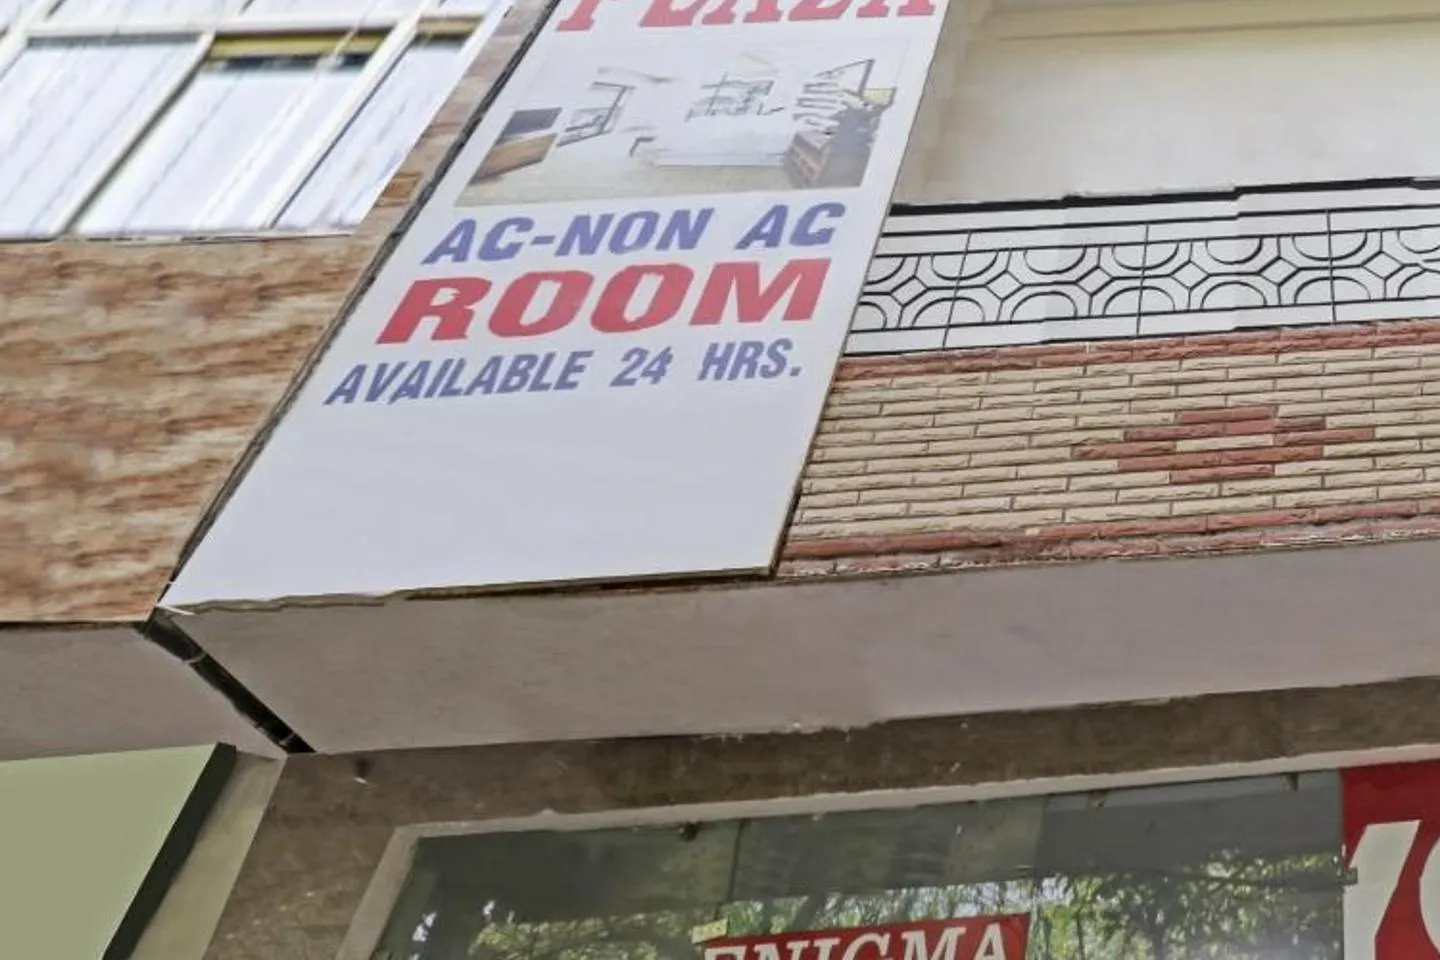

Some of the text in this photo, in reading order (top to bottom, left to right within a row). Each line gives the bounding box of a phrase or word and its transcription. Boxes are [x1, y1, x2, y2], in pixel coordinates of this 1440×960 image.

[421, 202, 846, 265] AC-NON AC
[375, 257, 832, 344] ROOM
[322, 338, 802, 406] AVAILABLE 24 HRS.
[704, 921, 1009, 960] GMA
